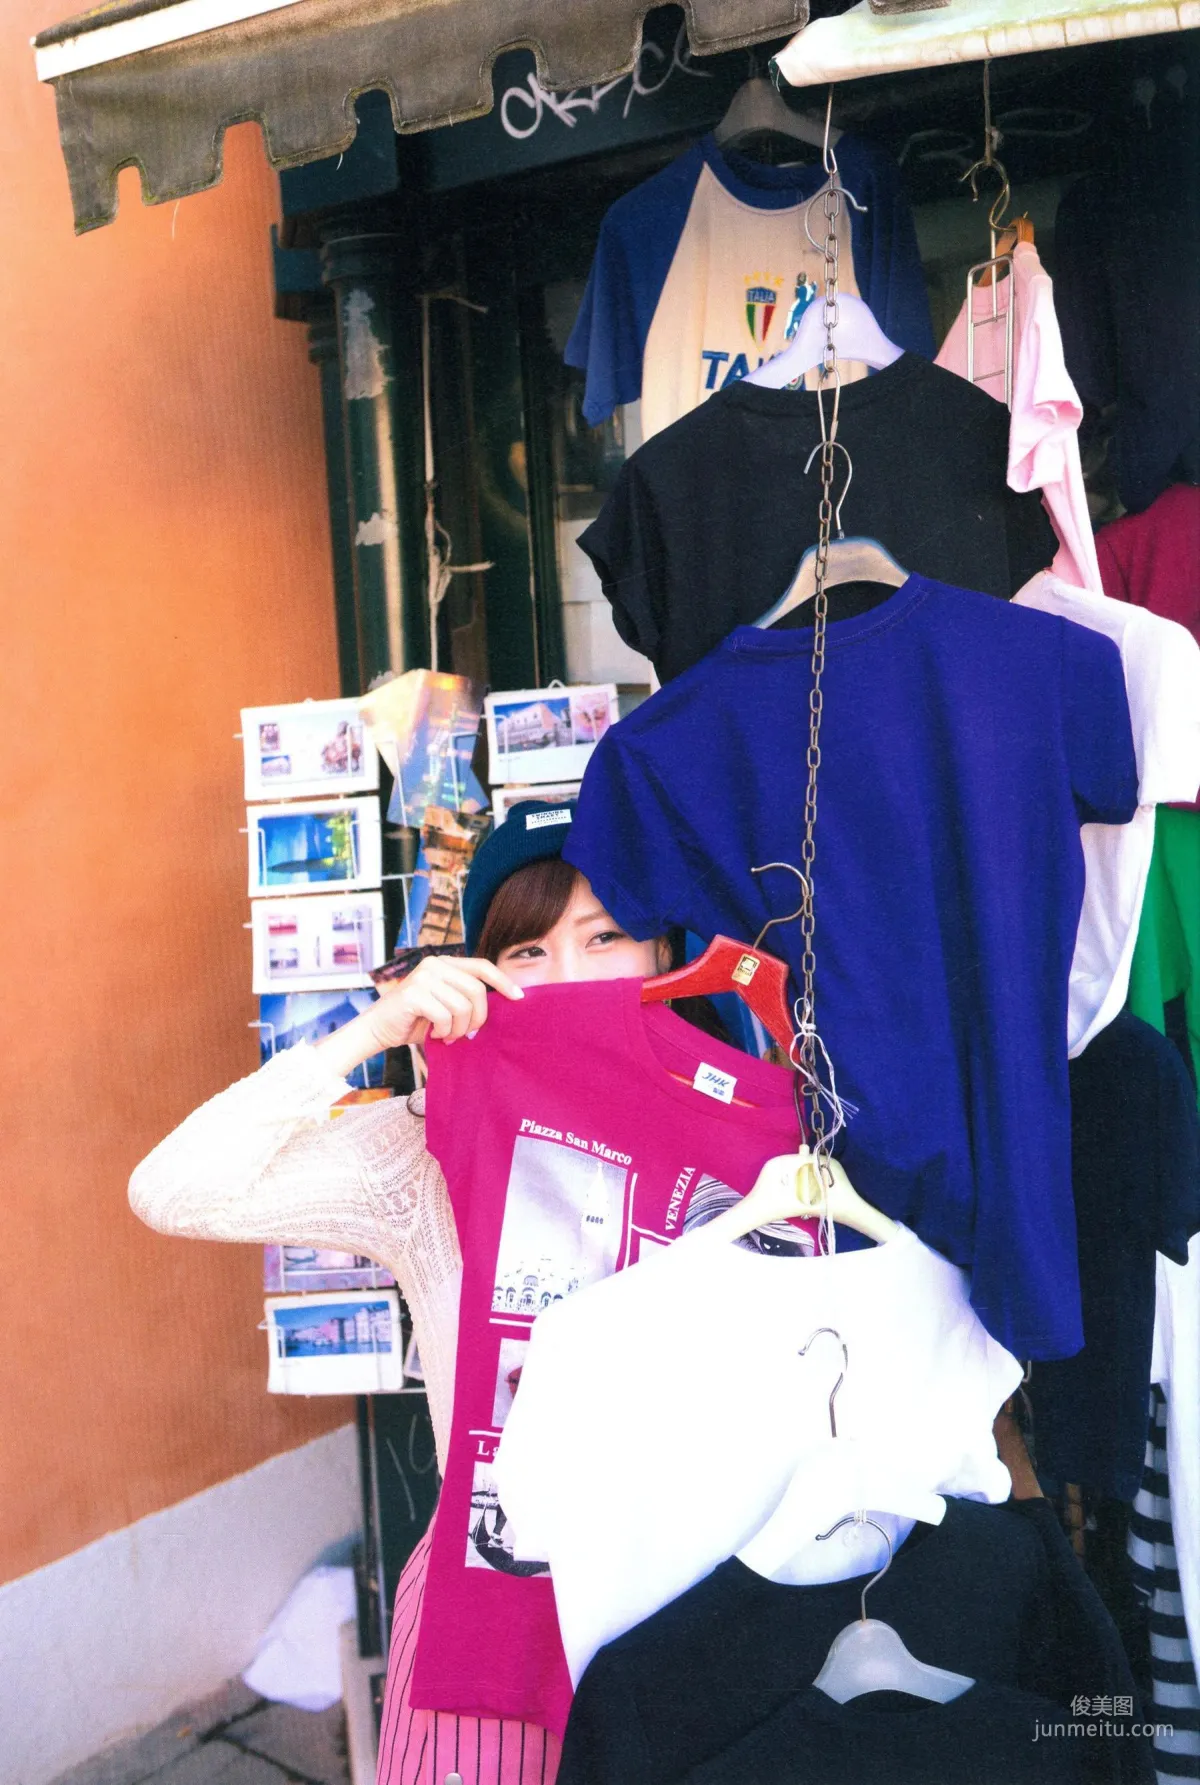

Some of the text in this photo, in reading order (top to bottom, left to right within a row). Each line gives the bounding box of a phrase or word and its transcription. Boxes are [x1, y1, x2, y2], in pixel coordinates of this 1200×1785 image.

[702, 1072, 730, 1087] JHK
[518, 1118, 633, 1166] Piazza San Marco
[664, 1166, 697, 1231] VENEZIA
